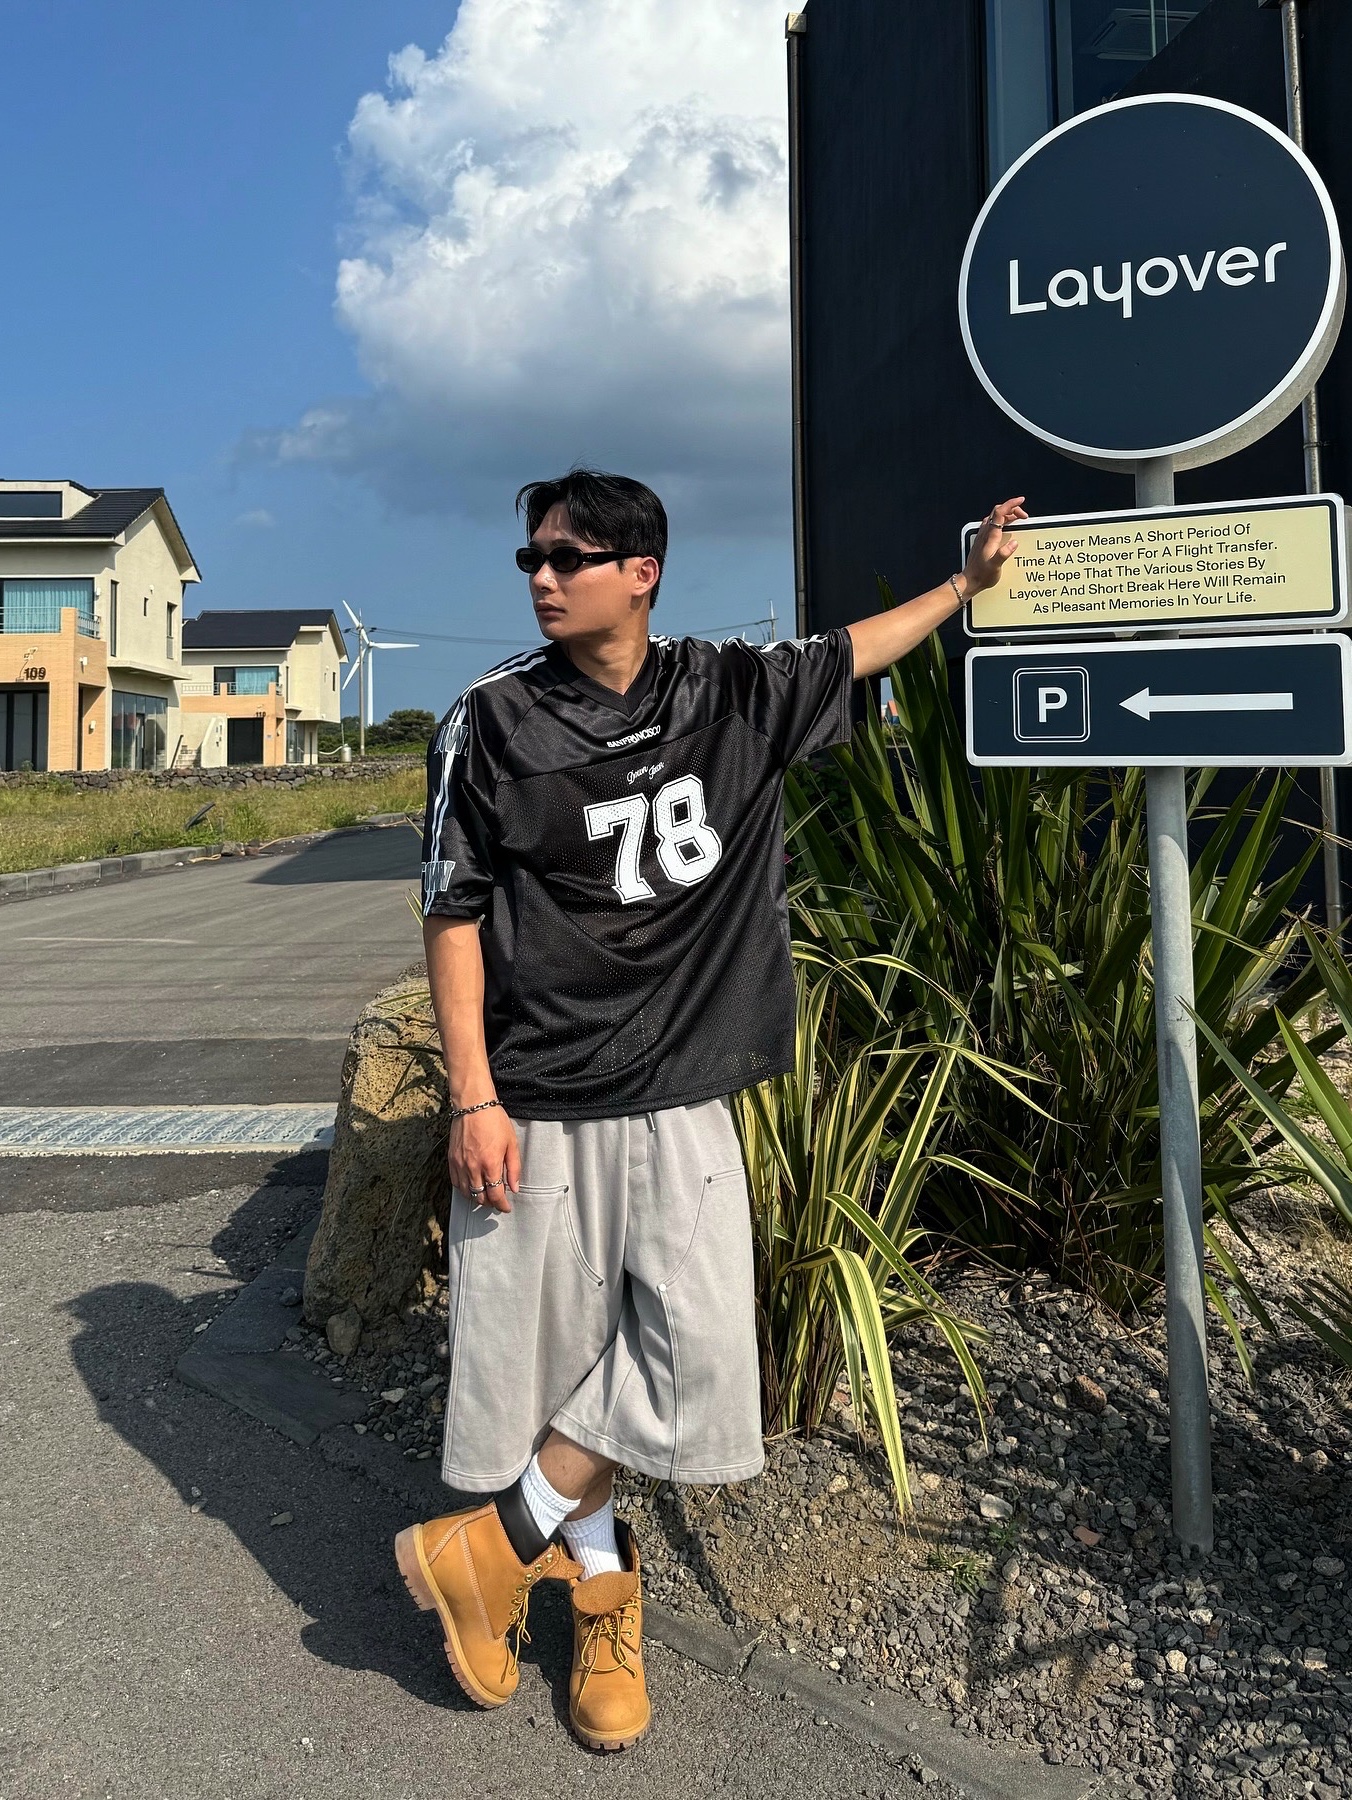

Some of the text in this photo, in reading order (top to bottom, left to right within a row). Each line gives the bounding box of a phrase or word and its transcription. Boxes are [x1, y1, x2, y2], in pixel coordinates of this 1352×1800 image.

[1008, 241, 1287, 319] Layover
[1036, 522, 1251, 552] Layover Means A Short Period Of
[1013, 539, 1278, 568] Time At A Stopover For A Flight Transfer.
[1025, 556, 1266, 583] We Hope That The Various Stories By
[1009, 572, 1286, 601] Layover And Short Break Here Will Remain
[1032, 591, 1256, 614] As Pleasant Memories In Your Life.
[23, 666, 47, 681] 109
[1038, 686, 1068, 723] P
[583, 774, 722, 904] 78
